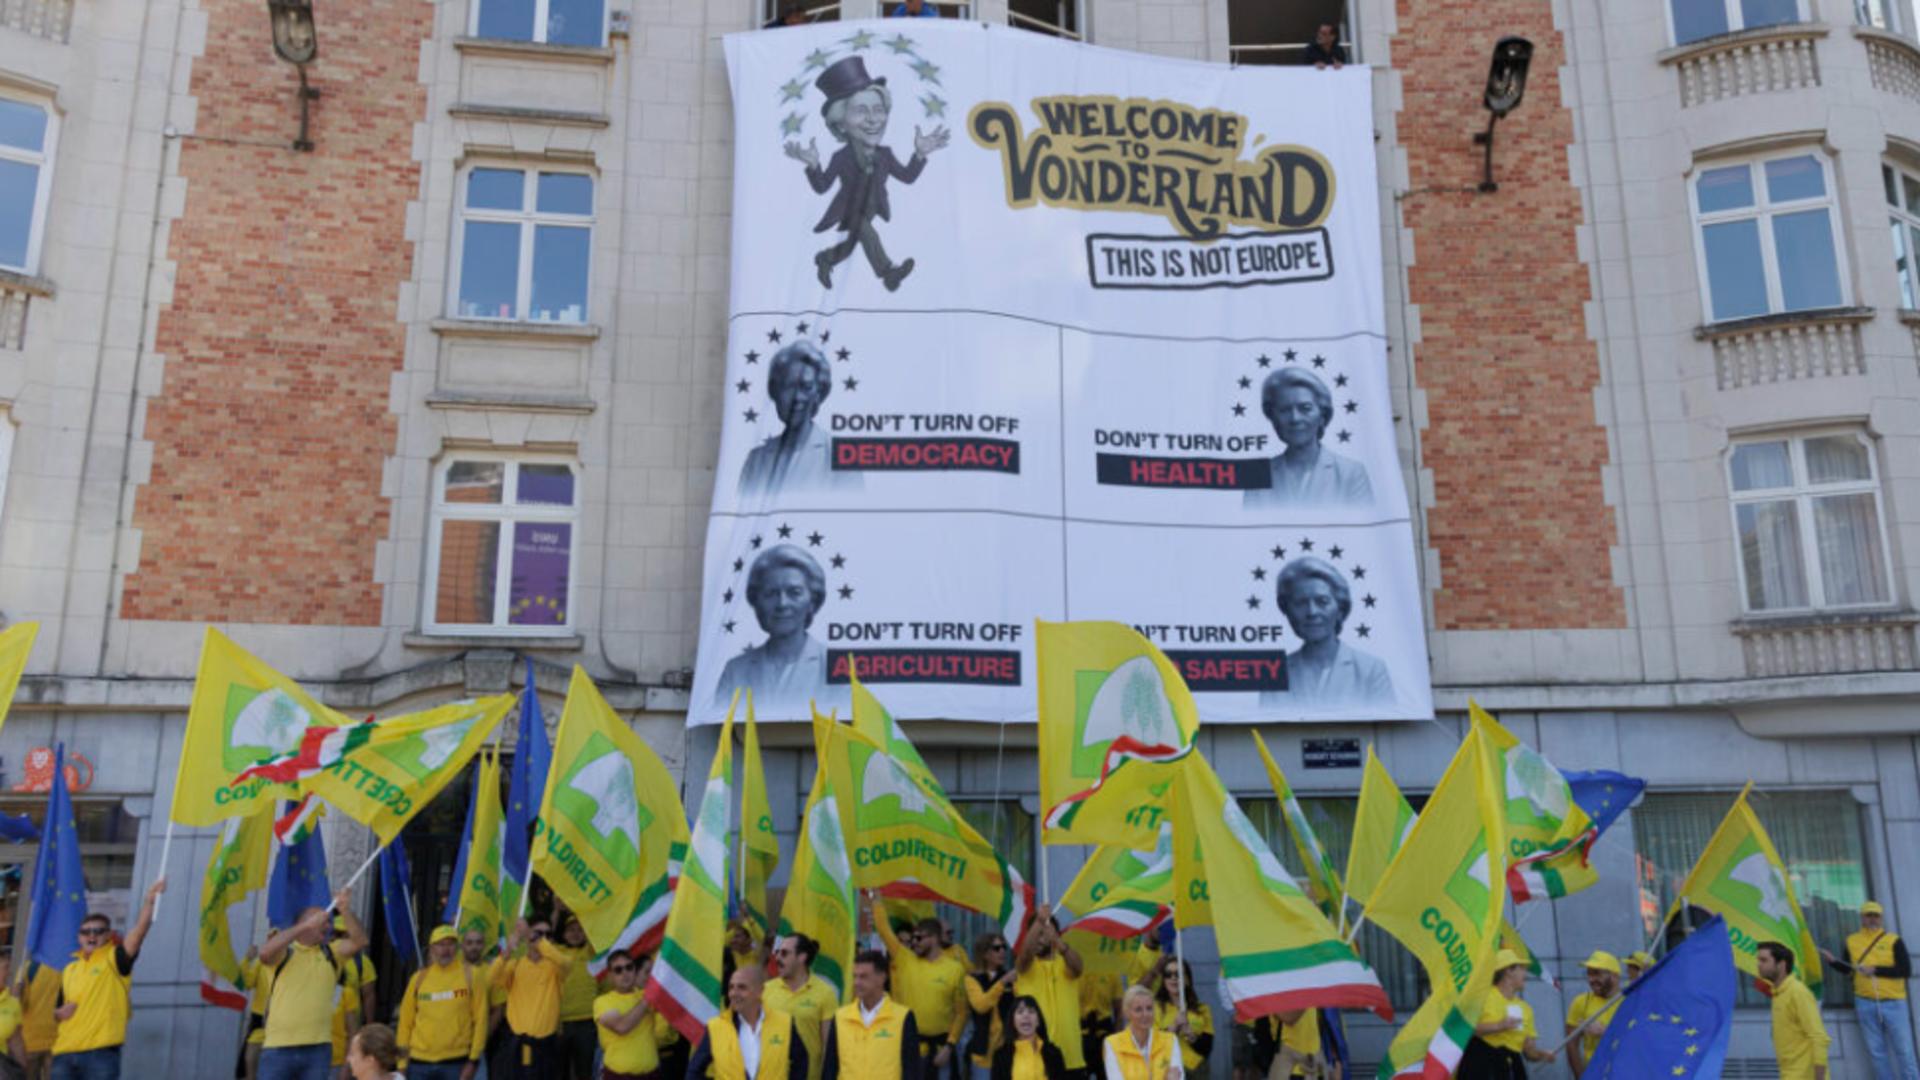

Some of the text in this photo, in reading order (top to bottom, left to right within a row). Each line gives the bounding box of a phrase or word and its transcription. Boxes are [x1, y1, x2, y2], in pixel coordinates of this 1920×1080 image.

[1040, 102, 1238, 148] WELCOME
[1117, 140, 1149, 161] TO
[974, 108, 1329, 239] VONDERLAND
[1101, 241, 1321, 277] THIS IS NOT EUROPE
[831, 414, 1019, 434] DON'T TURN OFF
[1094, 428, 1268, 451] DON'T TURN OFF
[837, 443, 1013, 467] DEMOCRACY
[1130, 460, 1237, 485] HEALTH
[827, 622, 1022, 643] DON'T TURN OFF
[1174, 624, 1237, 643] TURN
[1240, 625, 1283, 643] OFF
[831, 654, 1015, 678] AGRICULTURE
[1186, 658, 1282, 680] SAFETY
[854, 837, 967, 881] COLDIRETTI
